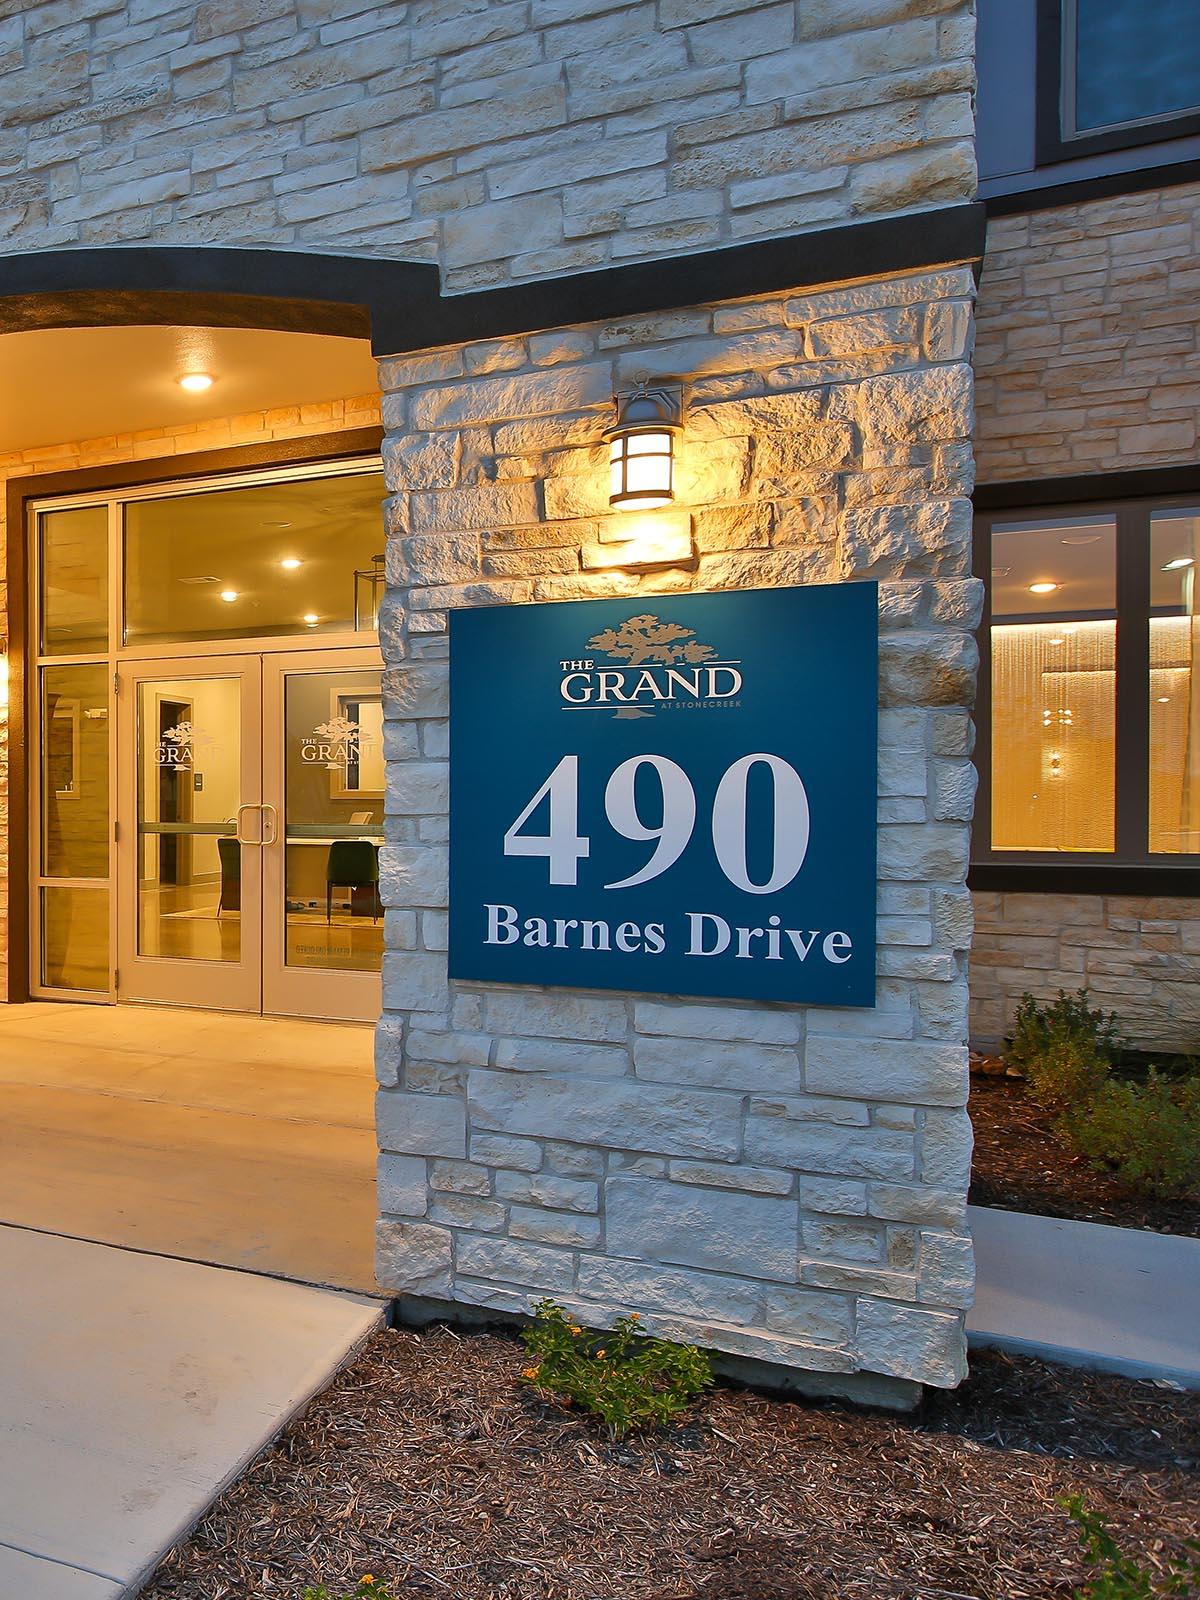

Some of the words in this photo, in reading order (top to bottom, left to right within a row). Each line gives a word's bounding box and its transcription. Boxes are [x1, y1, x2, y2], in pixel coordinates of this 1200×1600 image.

[560, 659, 595, 671] THE
[560, 667, 743, 703] GRAND
[675, 700, 742, 709] STONECREEK
[503, 752, 811, 895] 490
[482, 903, 667, 955] Barnes
[684, 911, 853, 964] Drive
